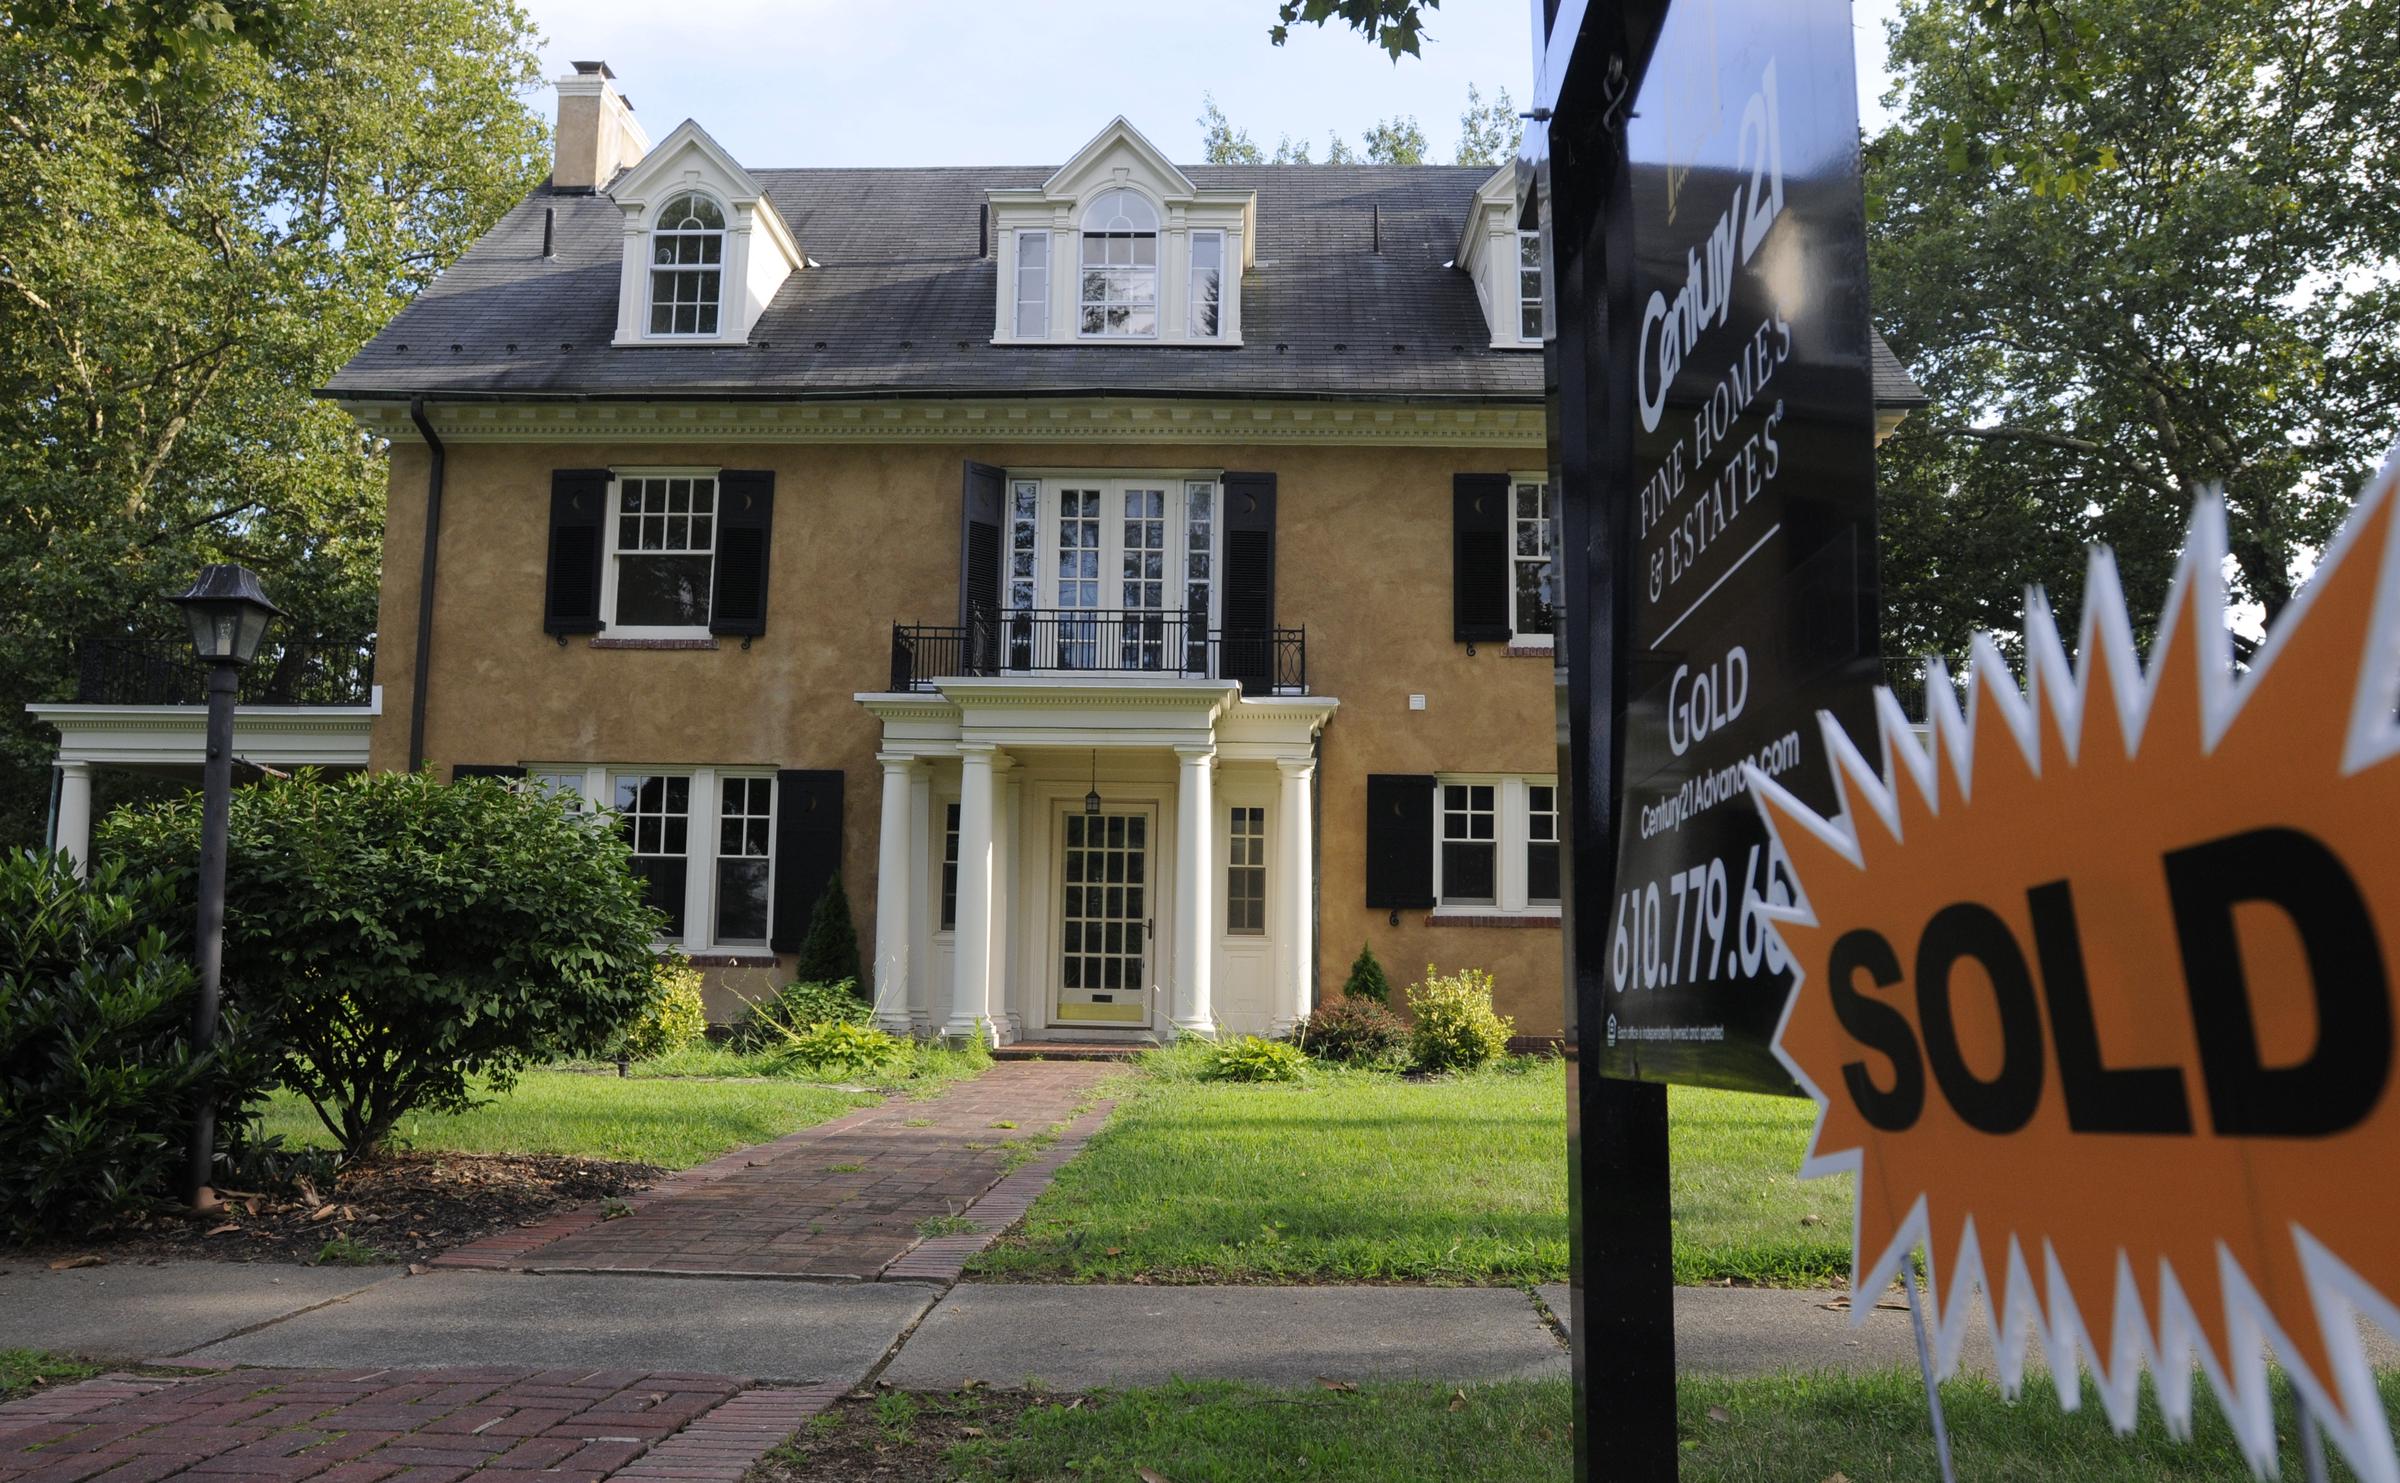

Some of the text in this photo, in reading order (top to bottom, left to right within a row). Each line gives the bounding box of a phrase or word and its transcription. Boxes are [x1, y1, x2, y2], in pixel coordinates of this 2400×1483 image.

[1639, 55, 1785, 434] Century 21
[1639, 304, 1792, 541] FINE HOMES
[1649, 546, 1666, 603] &
[1640, 730, 1800, 840] Century21Advanccom
[1667, 645, 1749, 757] GOLD
[1827, 824, 2394, 1138] SOLD
